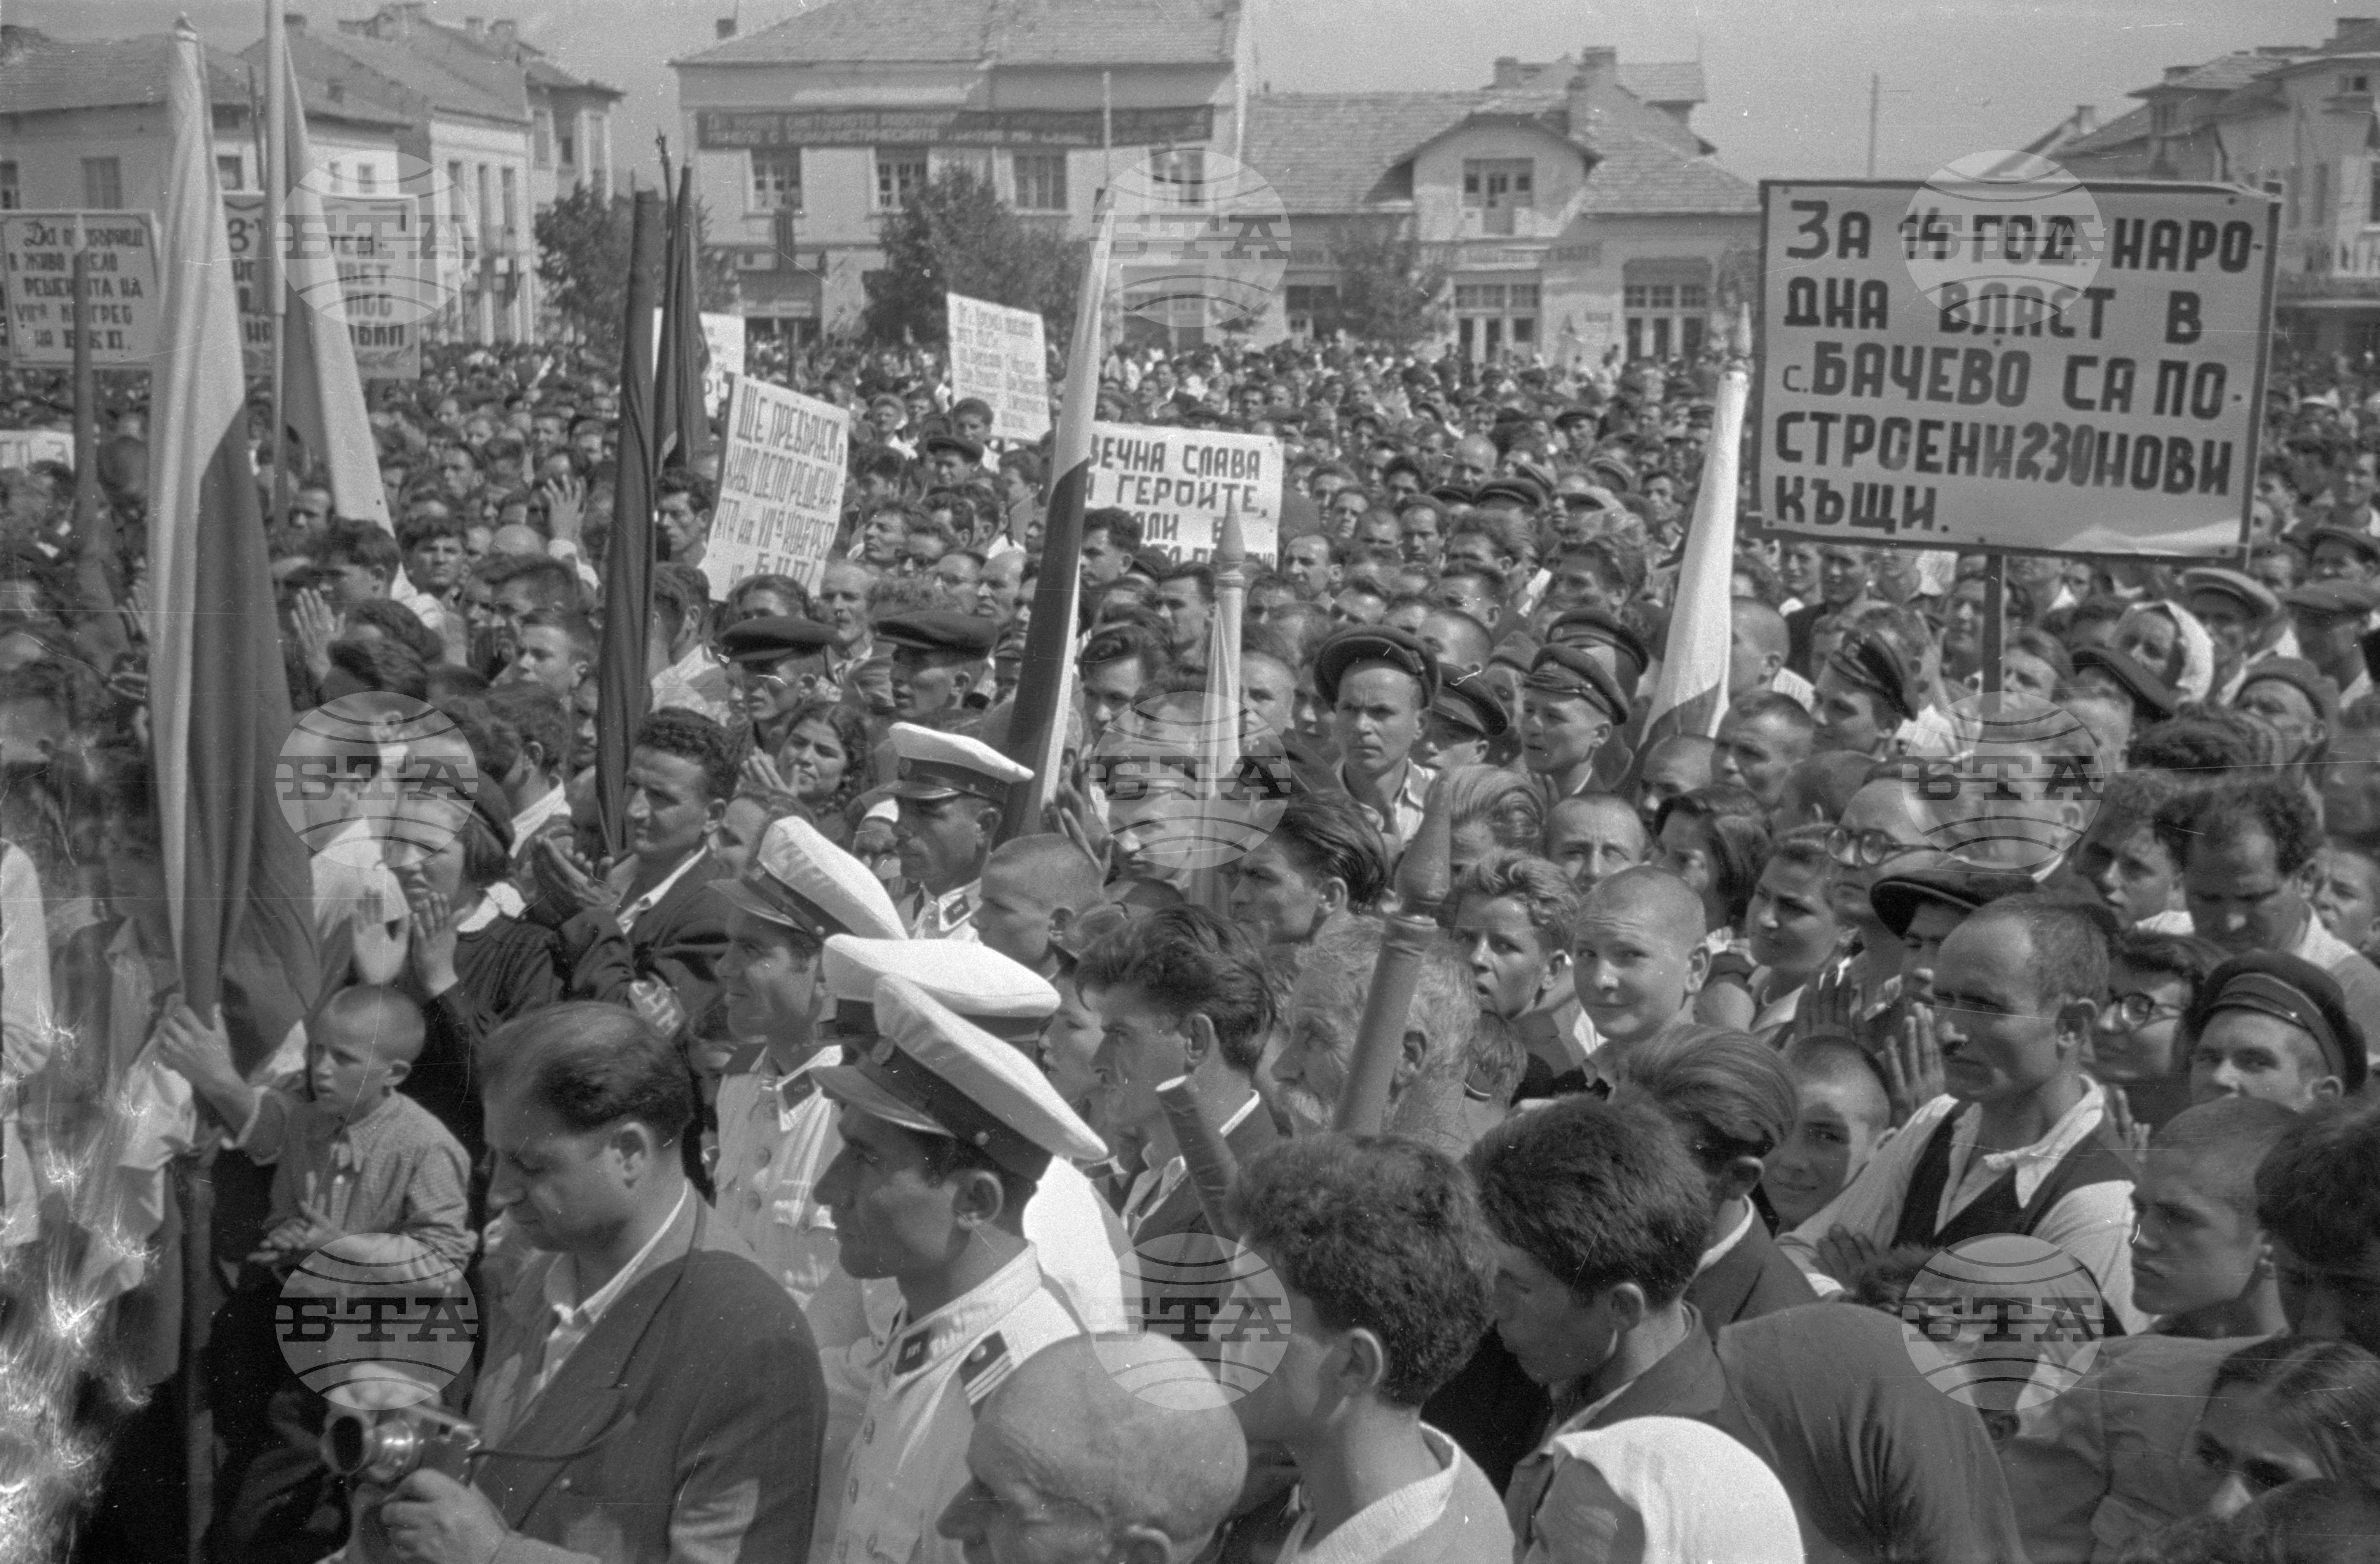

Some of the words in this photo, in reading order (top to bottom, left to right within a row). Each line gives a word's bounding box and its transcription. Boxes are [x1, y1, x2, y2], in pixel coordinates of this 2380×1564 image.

[1786, 199, 1871, 259] ЗА
[1784, 277, 1890, 330] ДНА
[1939, 282, 2116, 340] ВЛАСТ
[2164, 290, 2203, 345] В
[2062, 355, 2136, 415] СА
[1182, 444, 1261, 481] СЛАВА
[1774, 477, 1949, 534] КЪЩИ.
